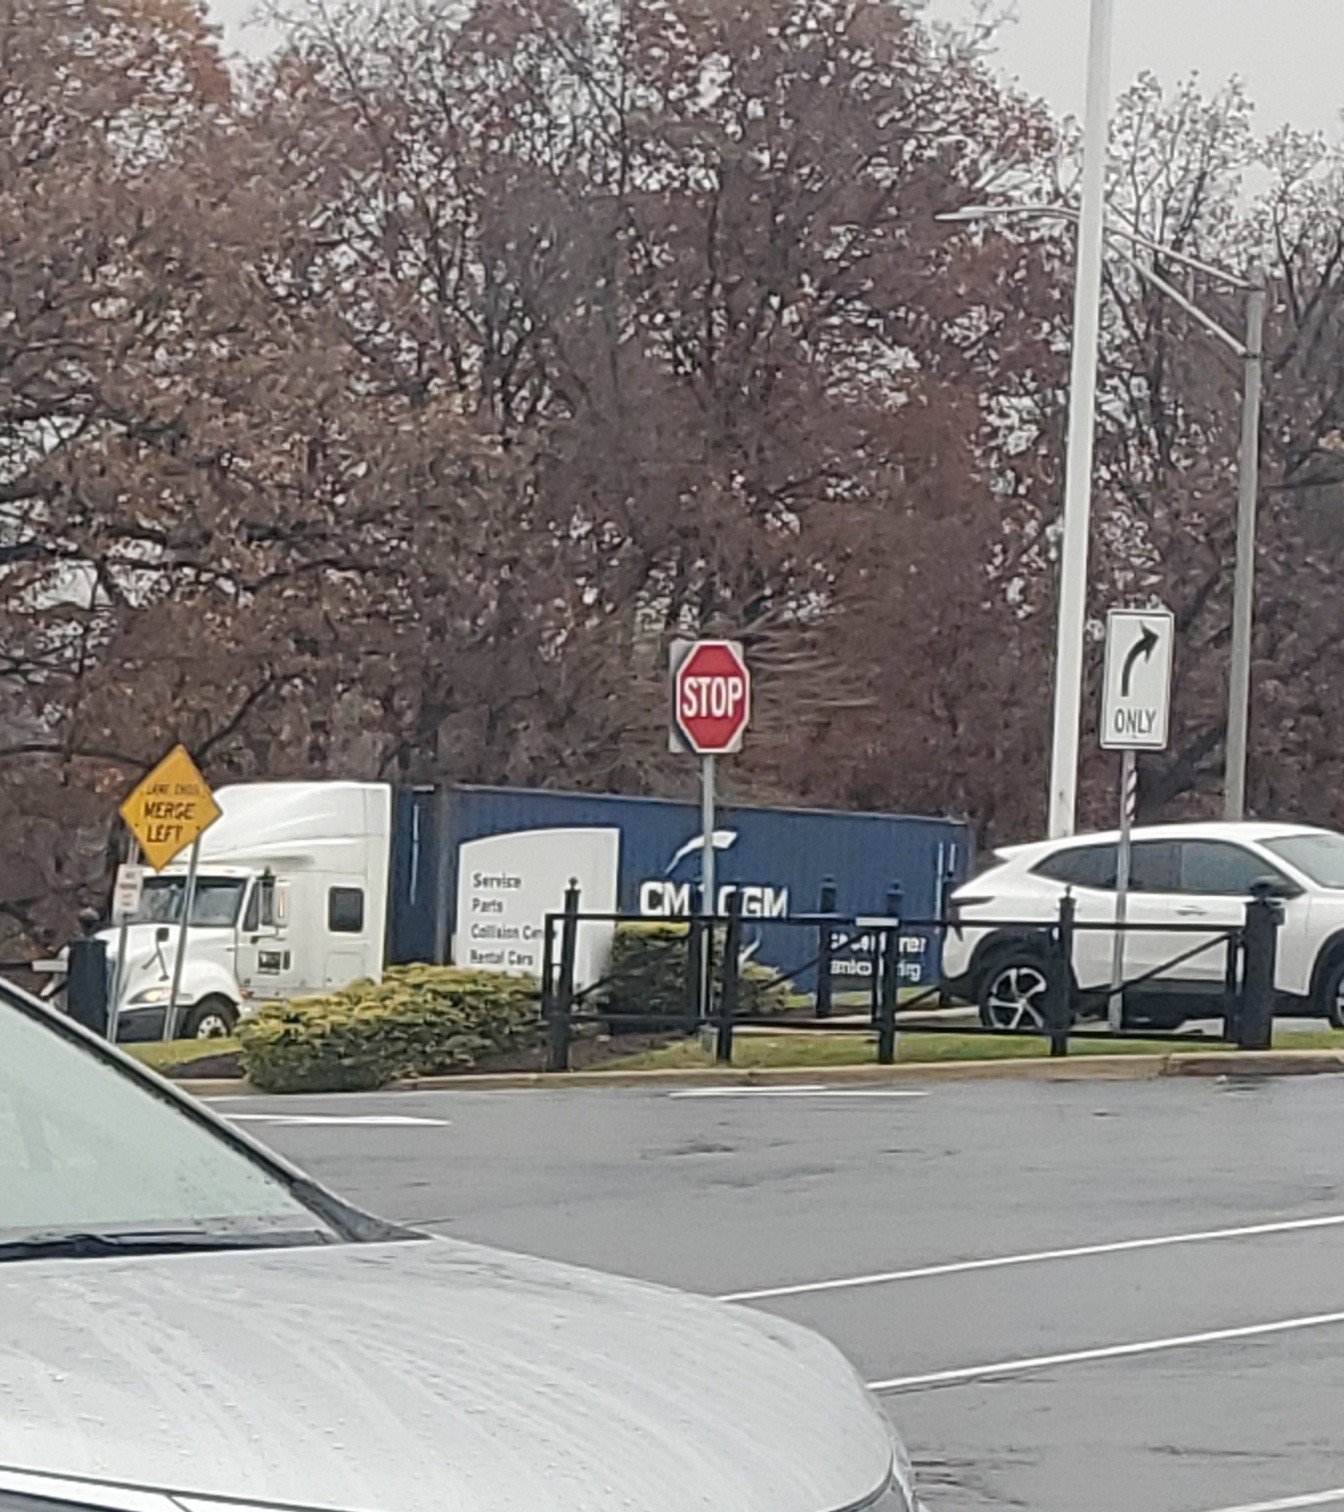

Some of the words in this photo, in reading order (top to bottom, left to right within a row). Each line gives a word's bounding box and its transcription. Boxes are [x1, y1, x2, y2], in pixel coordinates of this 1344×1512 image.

[682, 676, 743, 718] STOP
[1114, 707, 1157, 734] ONLY
[143, 802, 196, 820] MERGE
[146, 824, 184, 843] LEFT
[473, 873, 522, 889] Service
[472, 898, 504, 913] Parts
[640, 881, 706, 917] CM
[508, 951, 534, 966] Cars
